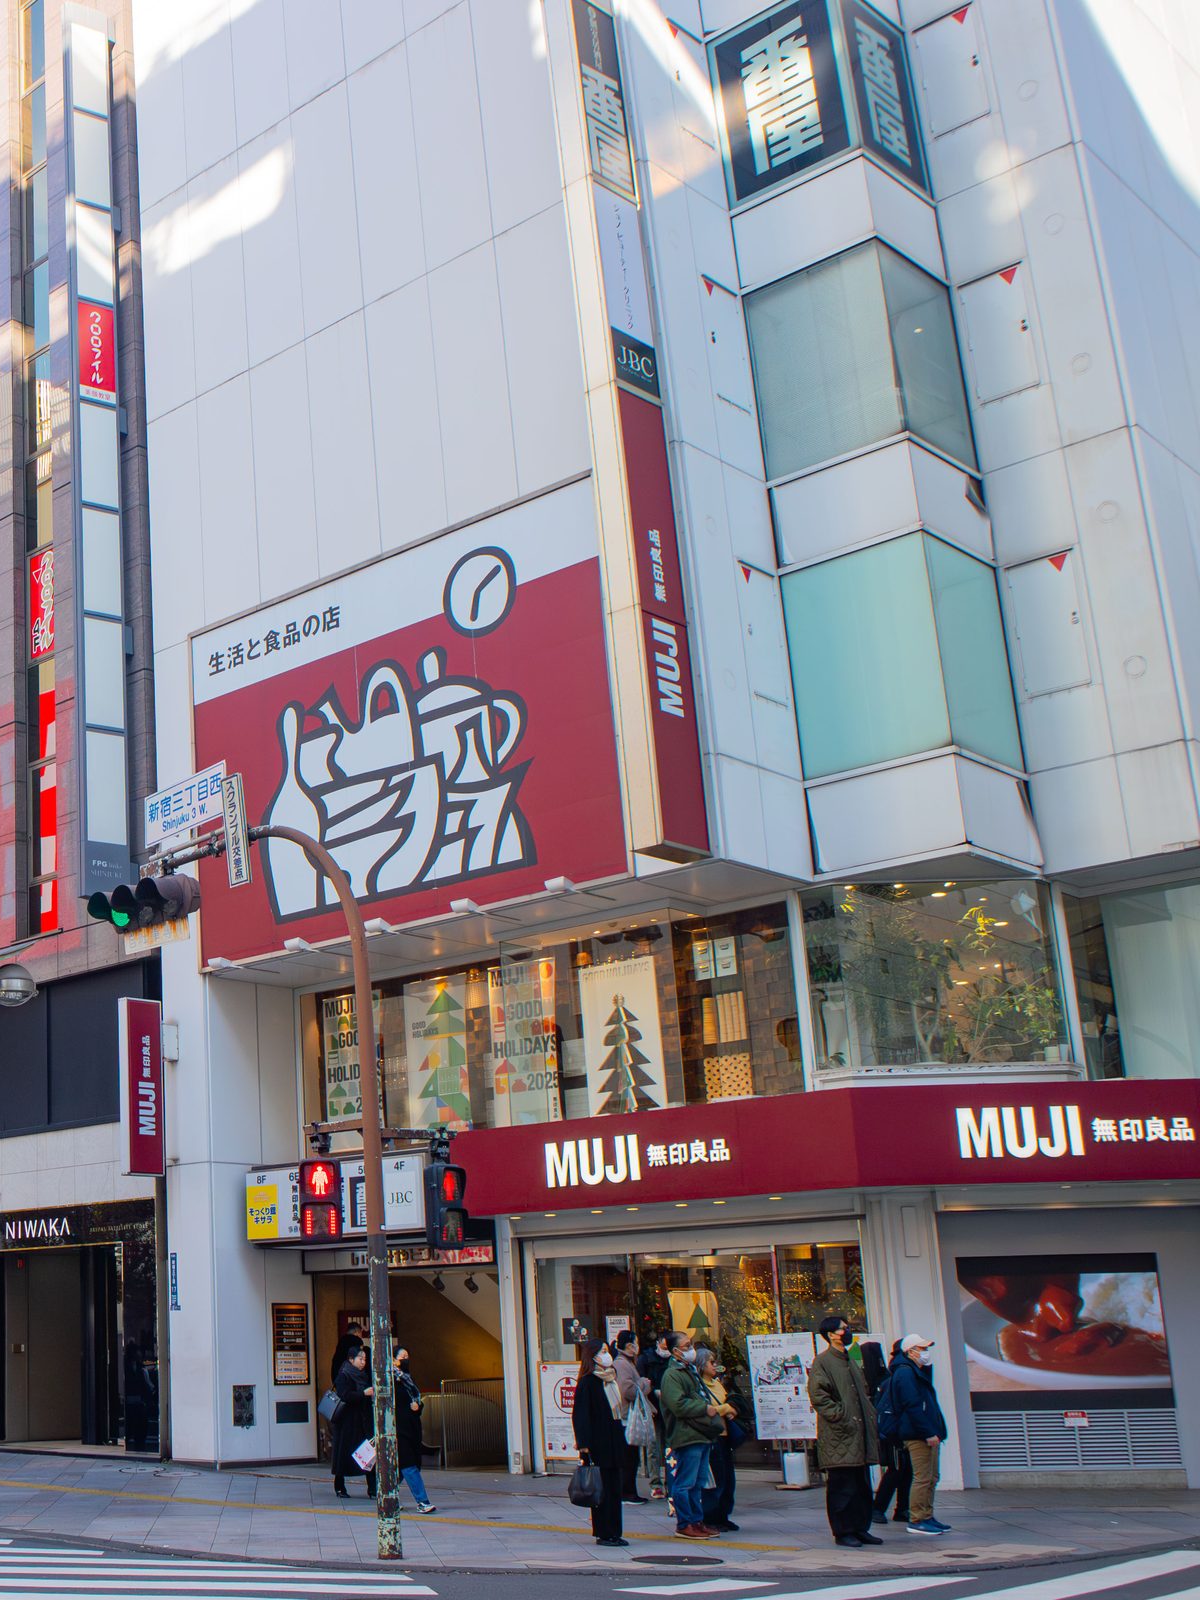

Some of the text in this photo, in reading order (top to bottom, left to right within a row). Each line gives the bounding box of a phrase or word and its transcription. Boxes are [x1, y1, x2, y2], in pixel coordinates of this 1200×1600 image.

[617, 344, 655, 380] JBC
[648, 528, 667, 603] 無印良品
[207, 605, 342, 677] 生活と食品の店
[652, 618, 685, 719] MUJI
[148, 772, 222, 823] 新宿三丁目西
[161, 801, 208, 833] Shinjuku 3 W.
[141, 1035, 151, 1078] 無印良品
[338, 1030, 360, 1049] GOO
[138, 1081, 156, 1136] MUJI
[955, 1104, 1086, 1160] MUJI
[1090, 1115, 1197, 1144] 無印良品
[393, 1161, 405, 1171] 4F
[544, 1134, 642, 1189] MUJI
[647, 1138, 731, 1168] 無印良品
[256, 1175, 267, 1185] 8F
[387, 1190, 413, 1205] JBC
[4, 1216, 71, 1240] NIWAKA
[253, 1215, 273, 1225] キサラ
